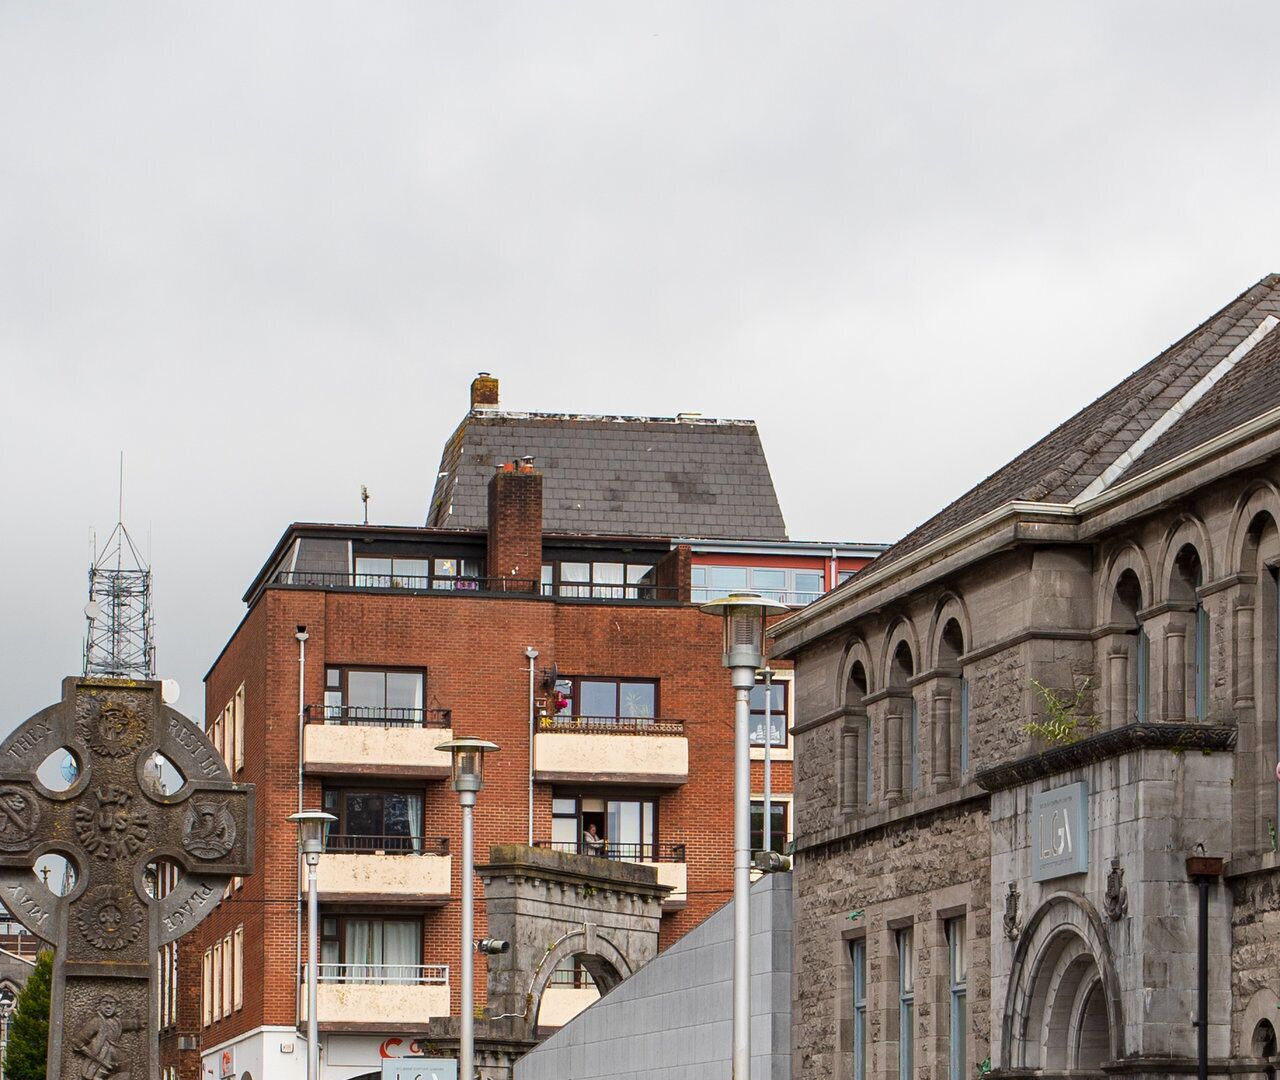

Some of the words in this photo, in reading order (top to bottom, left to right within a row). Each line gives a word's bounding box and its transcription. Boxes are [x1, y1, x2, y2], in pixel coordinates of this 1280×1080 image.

[7, 719, 54, 758] THEY
[168, 717, 206, 757] REST
[199, 757, 222, 779] IN
[8, 885, 50, 926] MAY
[163, 883, 215, 932] PEACE
